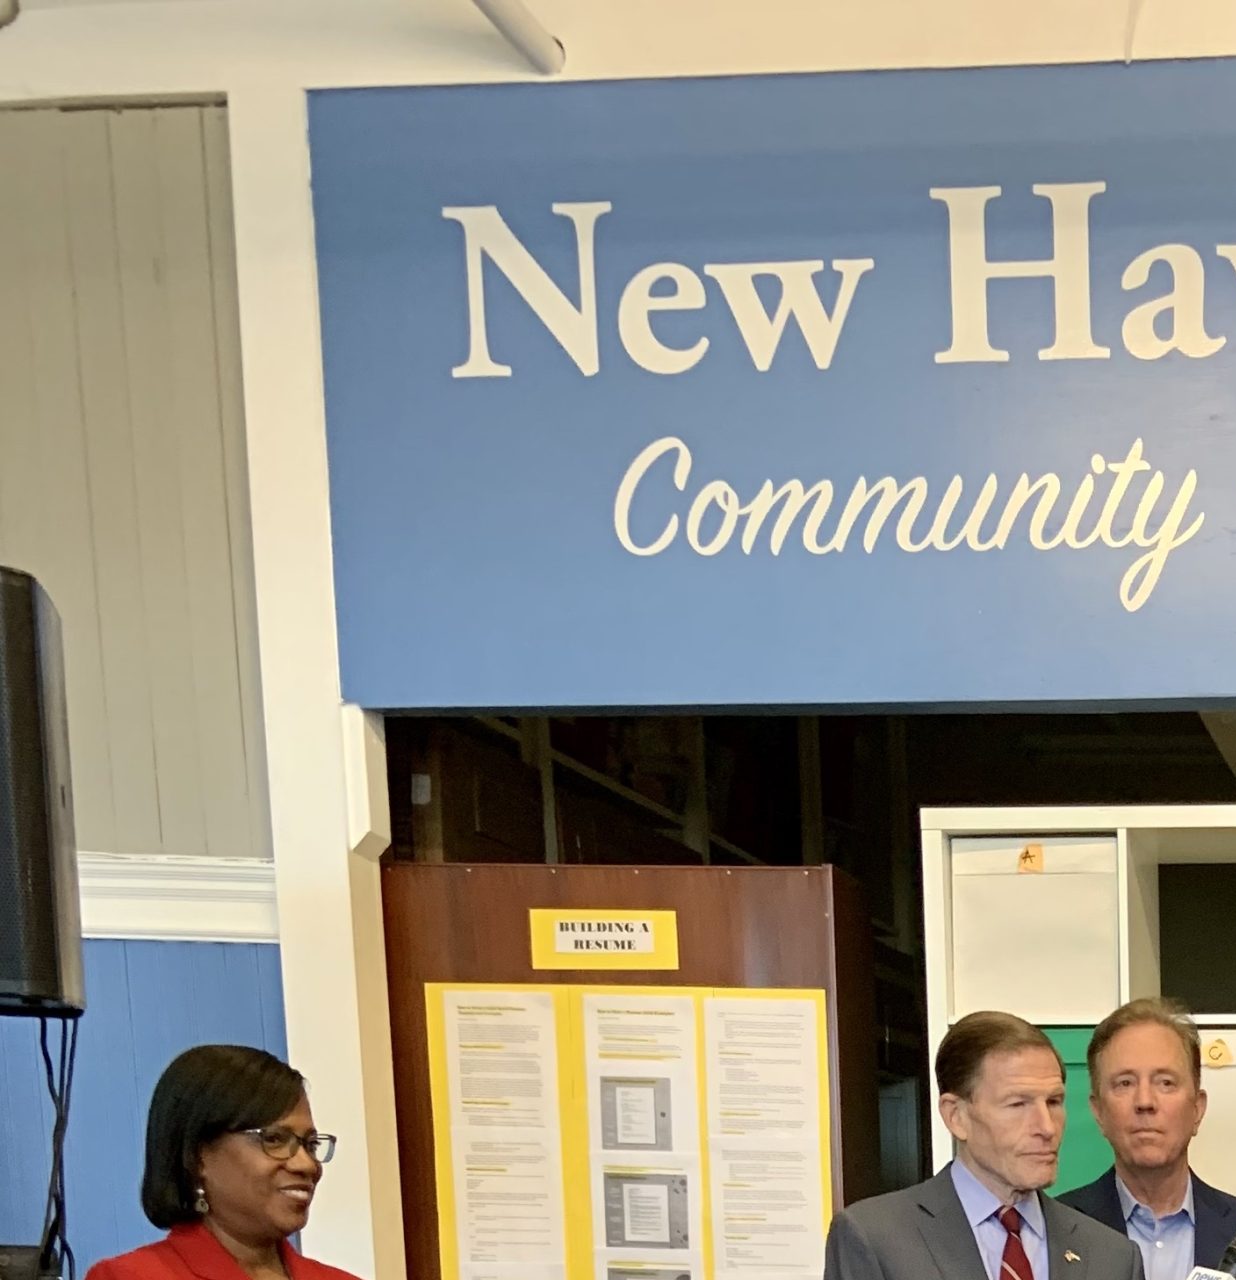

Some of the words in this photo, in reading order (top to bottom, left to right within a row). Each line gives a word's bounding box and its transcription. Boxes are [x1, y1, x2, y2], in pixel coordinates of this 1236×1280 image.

[442, 201, 873, 377] New
[613, 436, 1204, 610] Community
[1021, 848, 1036, 865] A
[559, 922, 635, 933] BUILDING
[639, 922, 650, 933] A
[573, 939, 637, 950] RESUME
